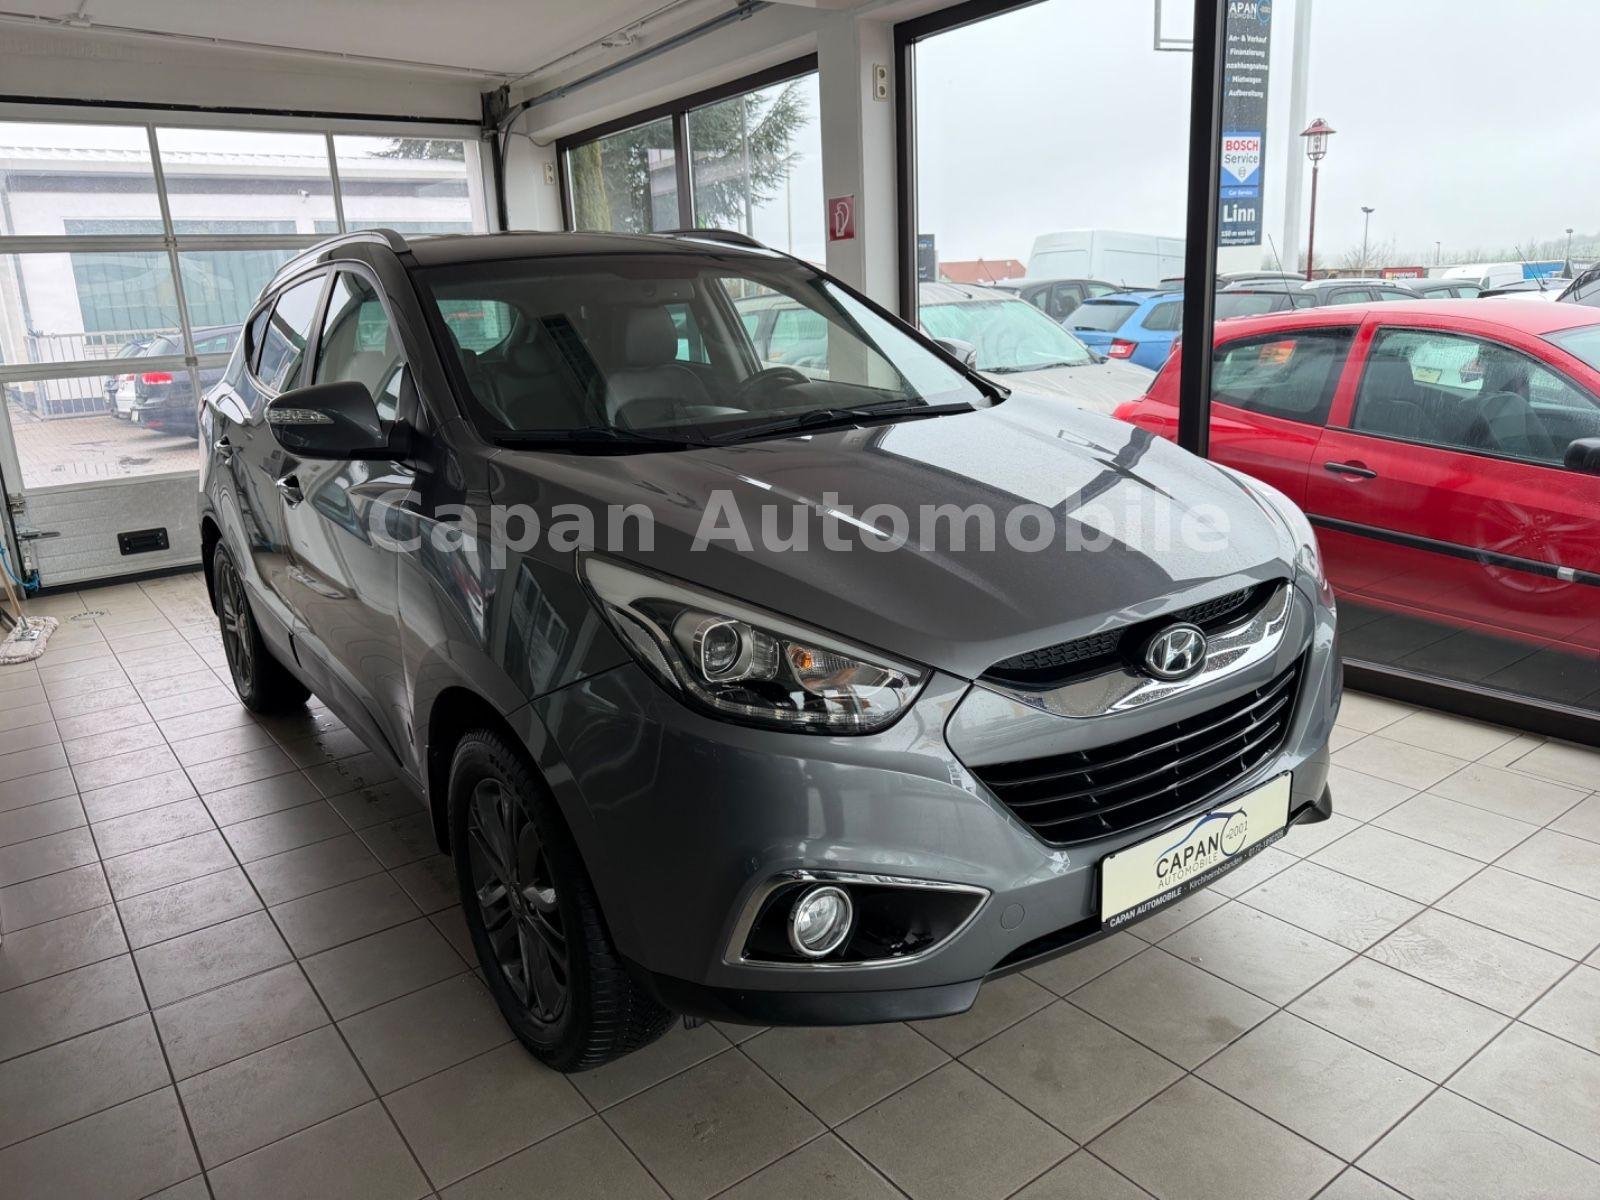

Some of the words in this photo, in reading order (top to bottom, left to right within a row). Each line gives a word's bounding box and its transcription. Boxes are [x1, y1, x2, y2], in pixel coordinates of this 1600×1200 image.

[1229, 2, 1257, 13] APAN
[1247, 35, 1267, 43] Verkauf
[1230, 48, 1265, 57] Finanzierung
[1226, 62, 1268, 71] nzahlungnahme
[1228, 89, 1264, 98] Aufbereitung
[1225, 140, 1259, 151] BOSCH
[1224, 153, 1258, 164] Service
[1223, 204, 1256, 222] Linn
[1156, 832, 1219, 878] CAPAN
[1159, 852, 1218, 889] AUTOMOBILE
[1109, 909, 1136, 927] CAPAN
[1136, 886, 1182, 915] AUTOMOBILE
